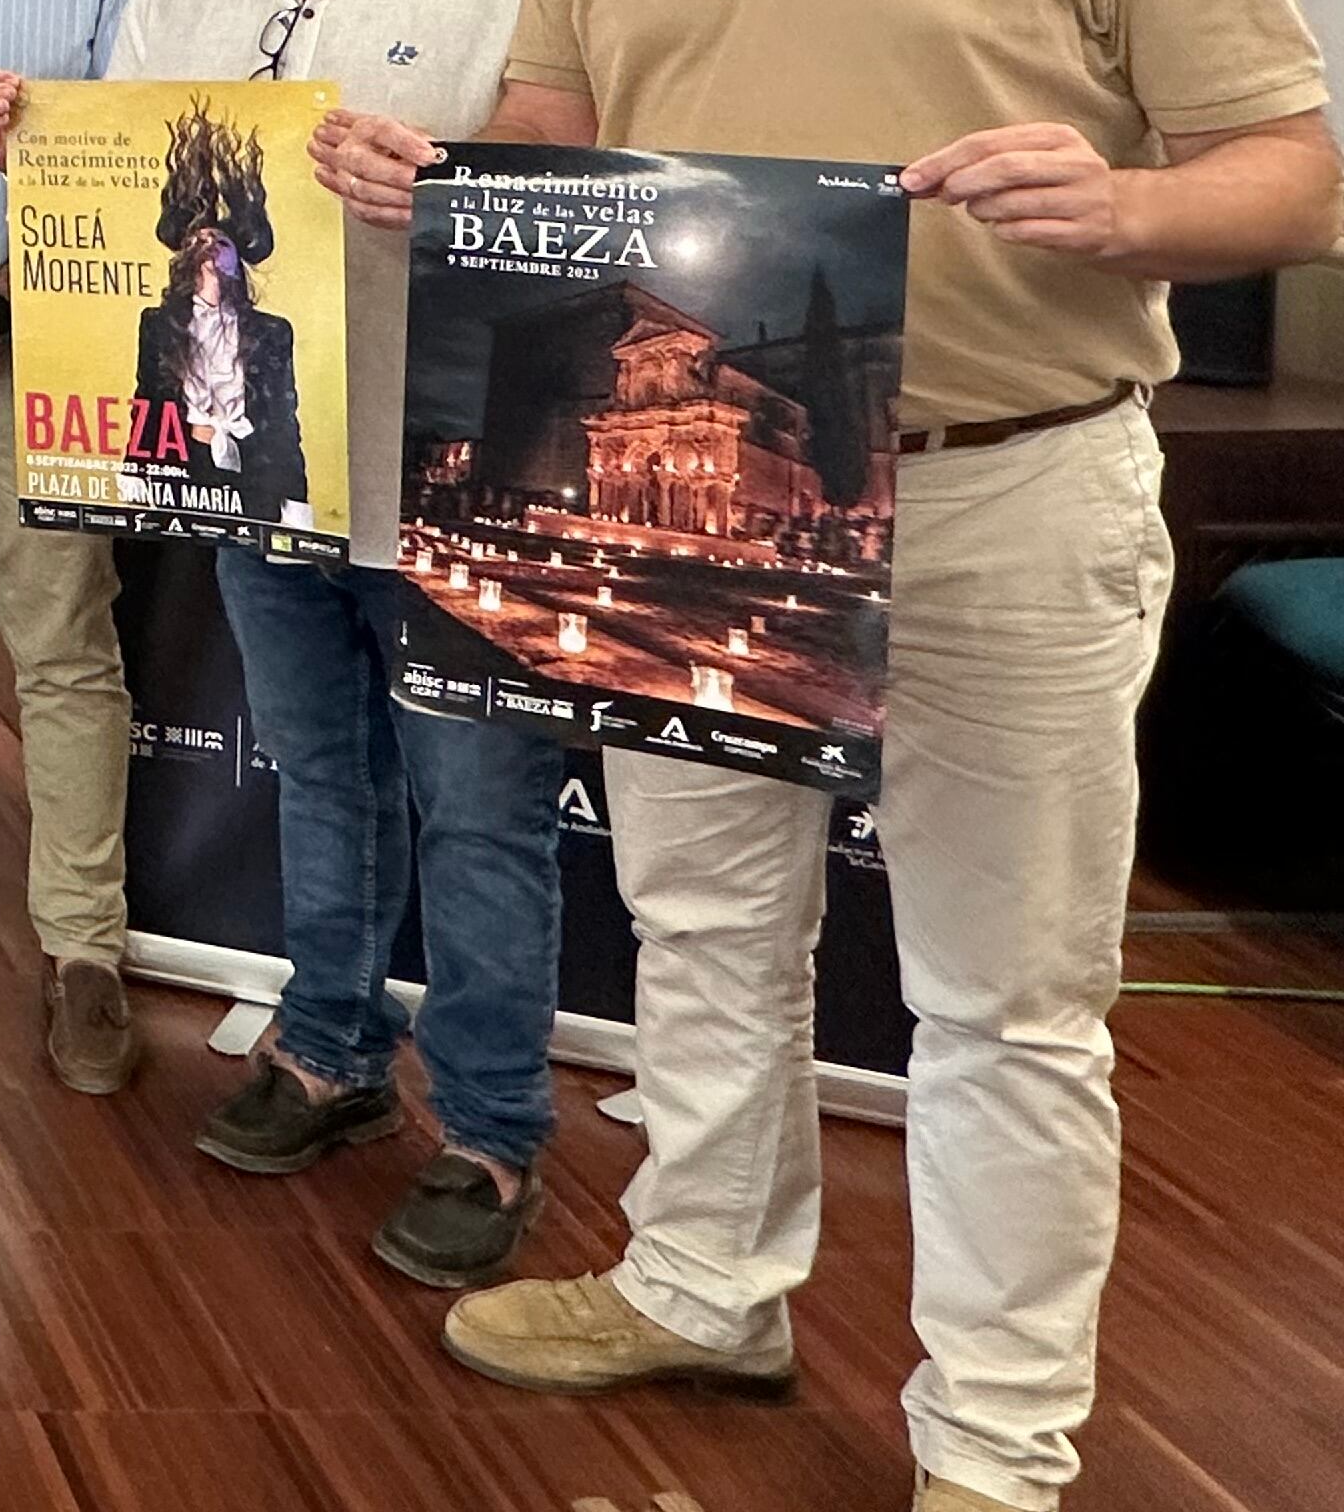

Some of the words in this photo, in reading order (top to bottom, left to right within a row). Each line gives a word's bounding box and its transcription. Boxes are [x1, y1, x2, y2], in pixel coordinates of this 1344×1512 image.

[17, 130, 47, 146] Con
[54, 131, 107, 146] motivo
[113, 132, 132, 147] de
[18, 149, 160, 170] Renacimiento
[41, 169, 70, 187] luz
[111, 170, 160, 189] velas
[454, 165, 658, 202] Renacimiento
[450, 198, 458, 209] a
[464, 196, 475, 209] la
[483, 190, 525, 215] luz
[533, 202, 550, 217] de
[555, 204, 575, 218] las
[582, 201, 655, 226] velas
[21, 204, 106, 250] SOLEÁ
[448, 213, 658, 269] BAEZA
[23, 249, 153, 298] MORENTE
[447, 254, 456, 266] 9
[460, 256, 563, 277] SEPTIEMBRE
[25, 392, 189, 462] BAEZA
[34, 455, 109, 472] SEPTIEMBRE
[28, 471, 82, 498] PLAZA
[88, 475, 110, 501] DE
[116, 477, 175, 507] SANTA
[181, 484, 244, 516] MARÍA
[403, 669, 443, 690] abisc
